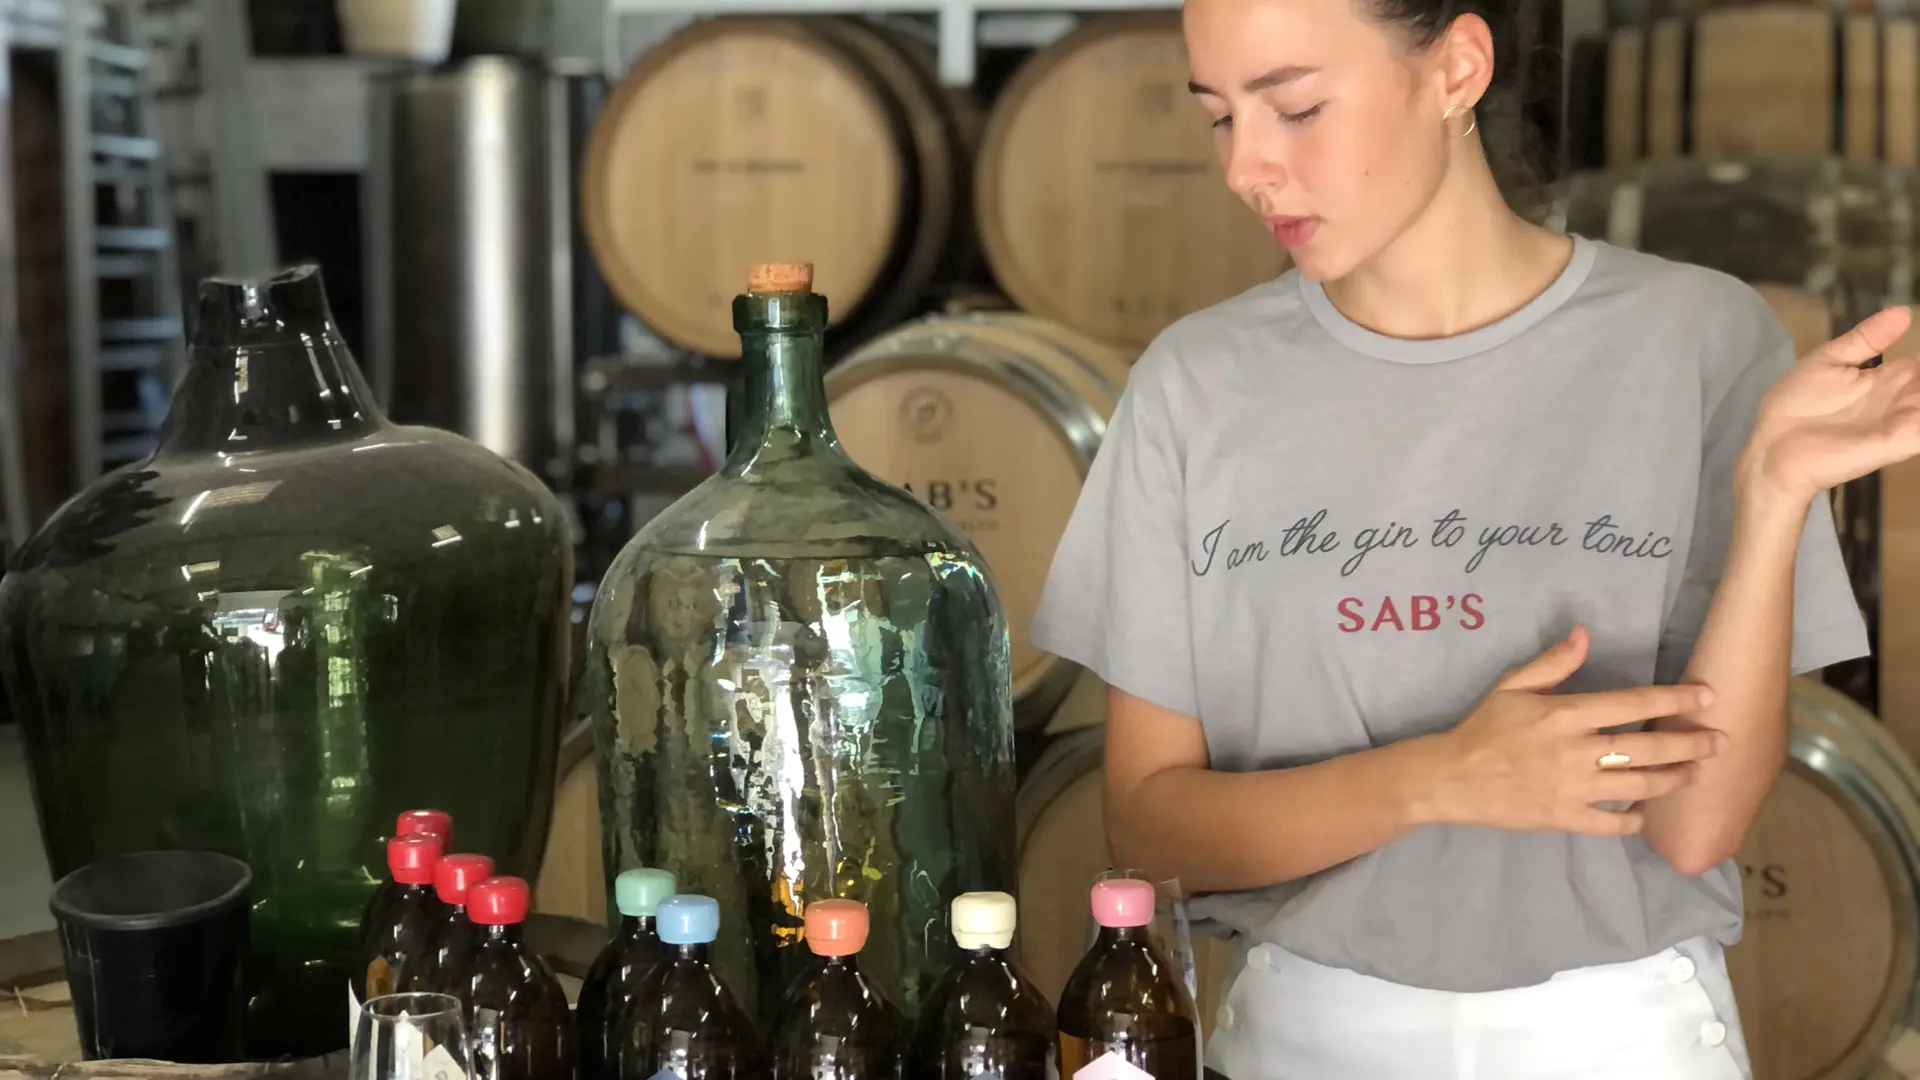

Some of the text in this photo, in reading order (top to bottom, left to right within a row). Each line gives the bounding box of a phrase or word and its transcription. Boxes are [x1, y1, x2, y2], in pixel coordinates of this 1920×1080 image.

[1190, 508, 1673, 577] I am the gin to your tonic
[1336, 593, 1485, 633] SAB'S
